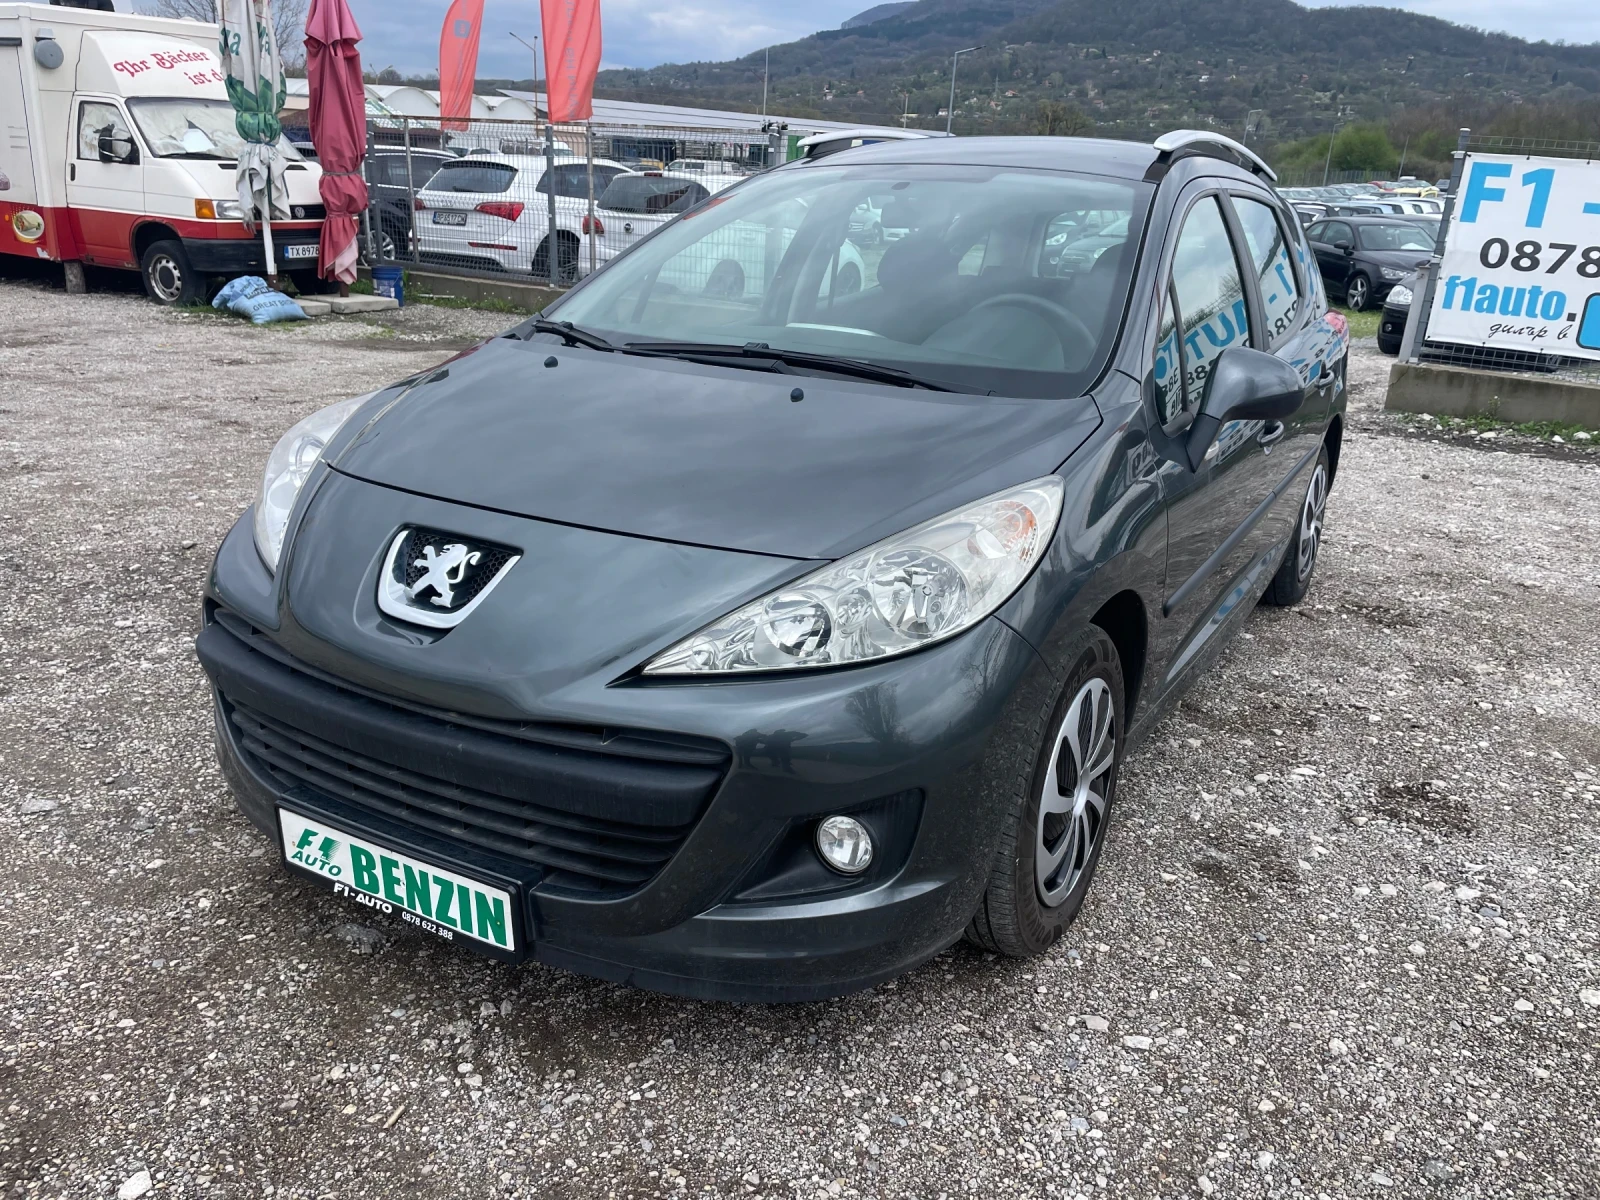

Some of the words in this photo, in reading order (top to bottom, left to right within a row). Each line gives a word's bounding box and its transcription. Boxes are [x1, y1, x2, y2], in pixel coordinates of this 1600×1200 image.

[114, 60, 152, 78] Ihr
[150, 50, 210, 70] Bäcker
[183, 70, 212, 86] ist
[211, 68, 225, 83] d
[1460, 162, 1555, 228] F1
[1479, 237, 1600, 279] 0878
[291, 849, 343, 877] AUTO
[333, 882, 394, 914] F1-AUTO
[350, 843, 508, 947] BENZIN
[401, 911, 421, 926] 0878
[422, 919, 437, 933] 622
[437, 926, 454, 940] 388
